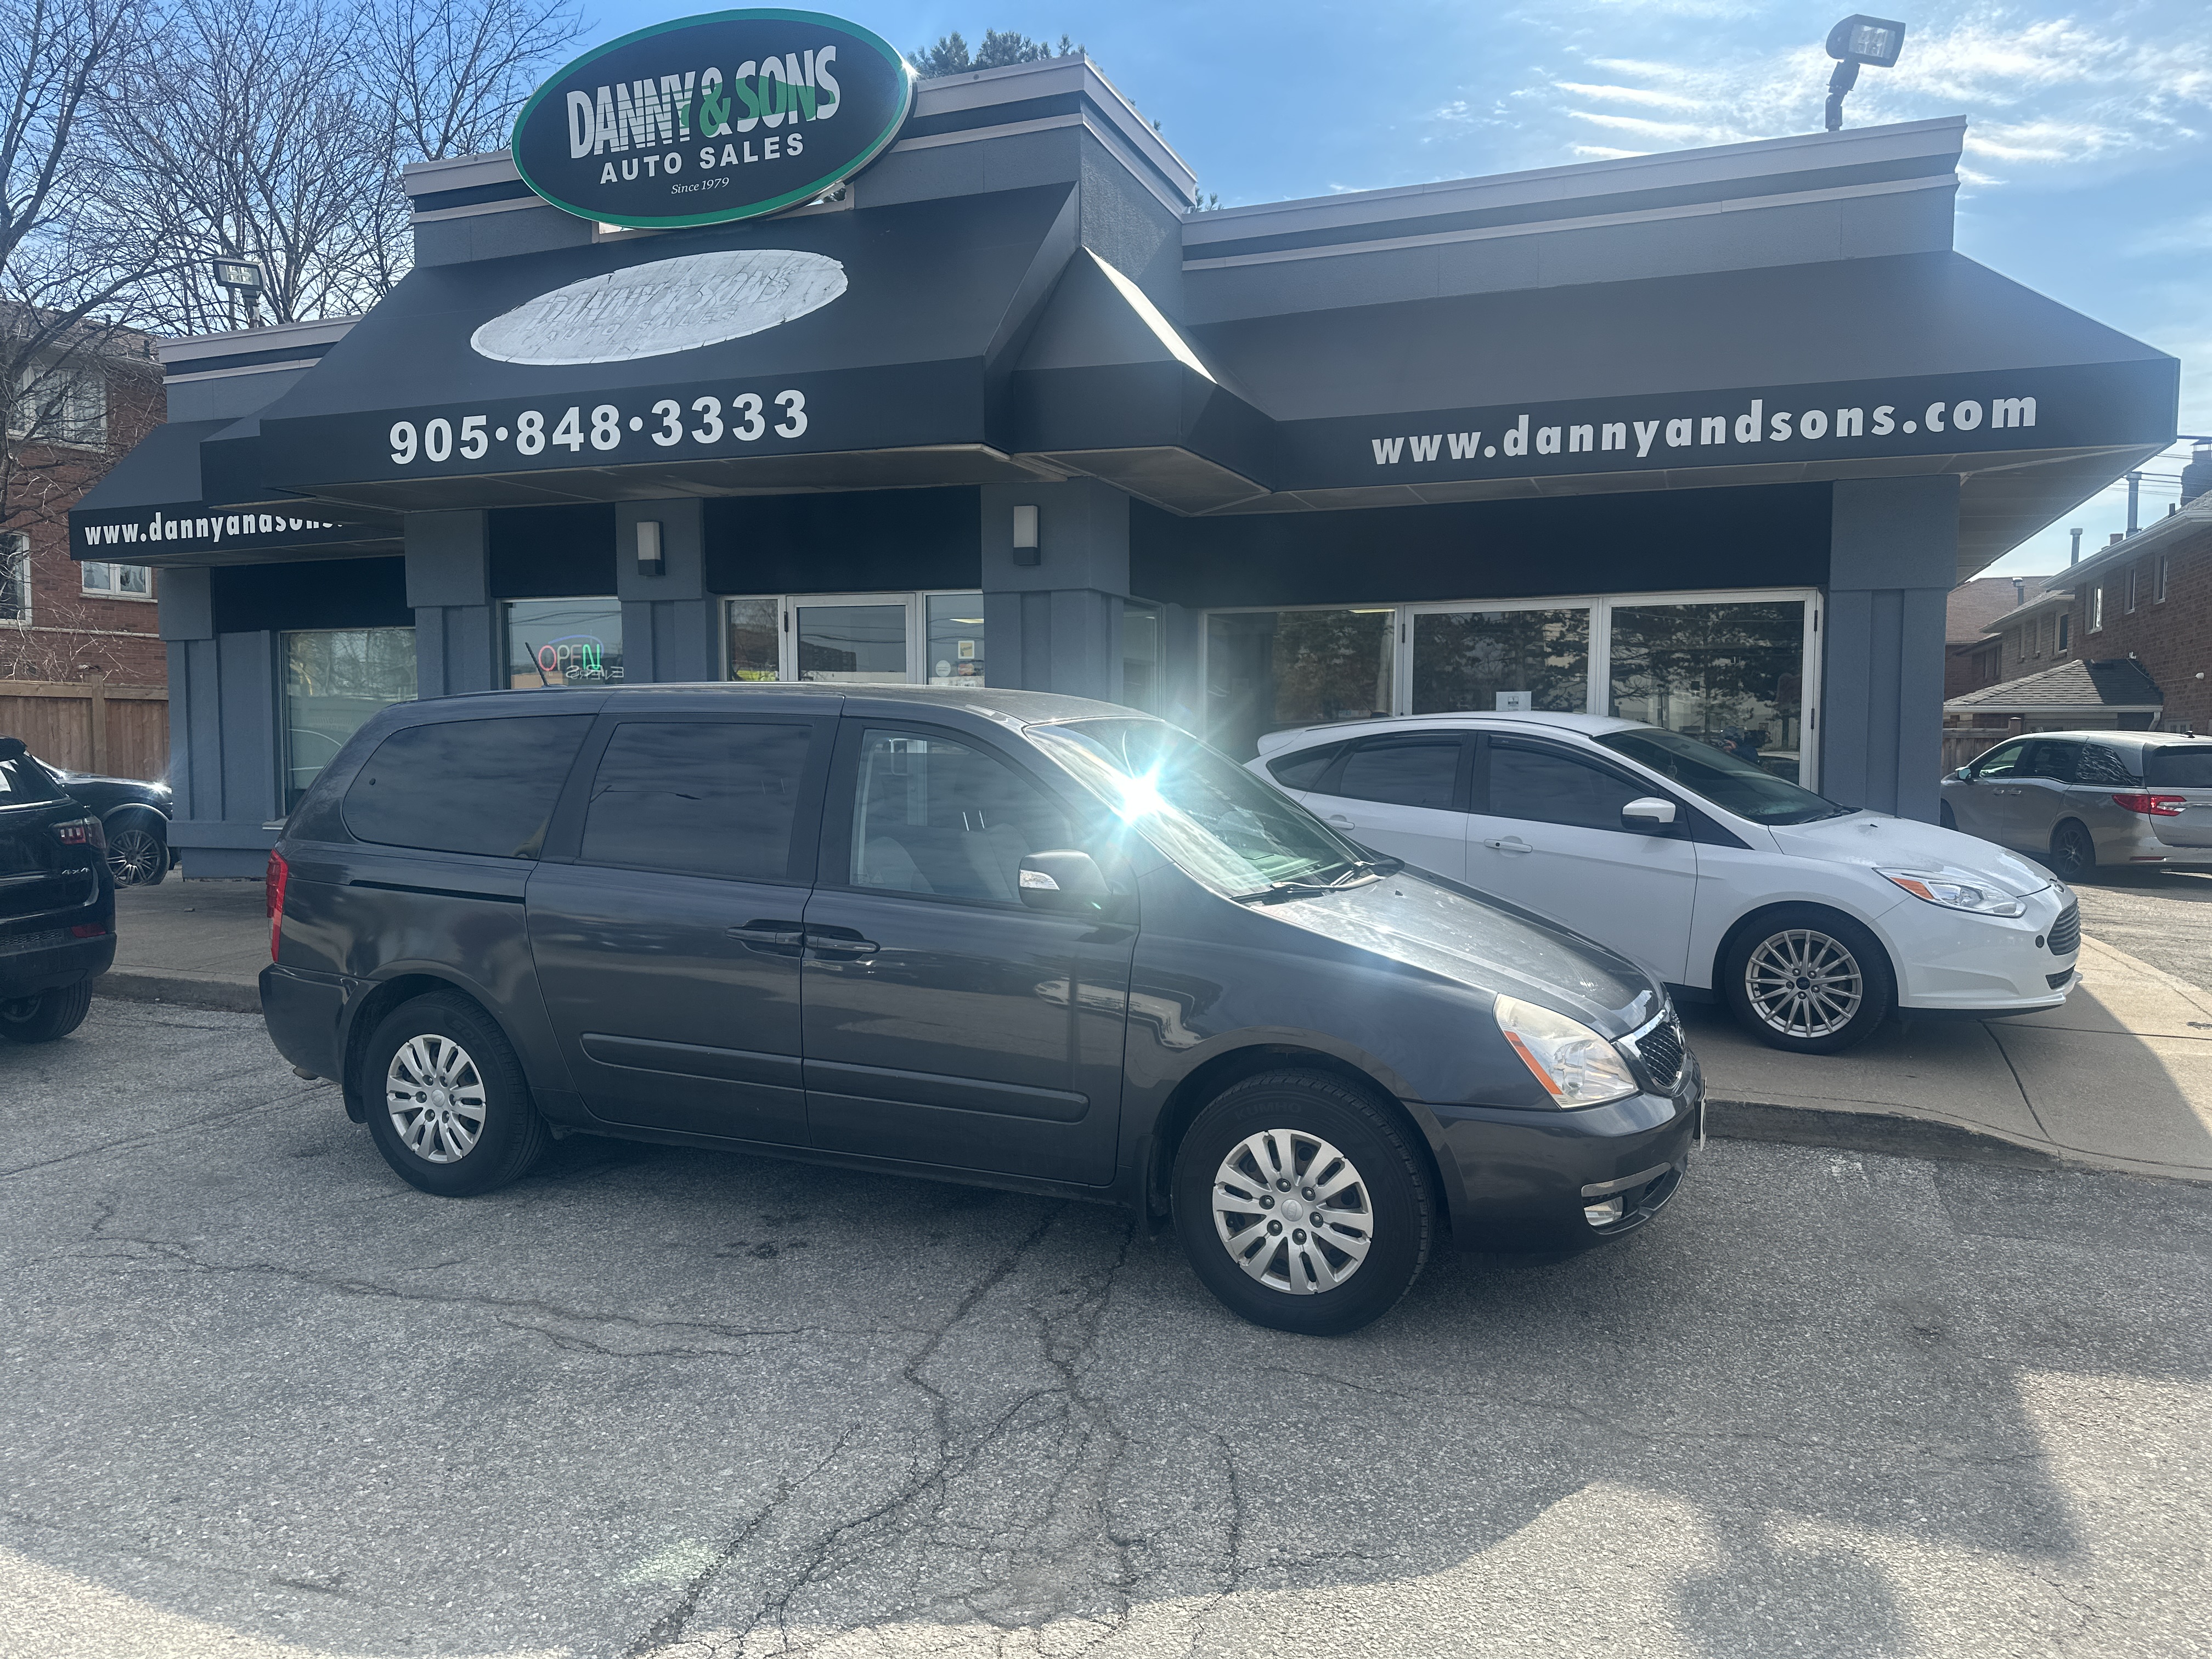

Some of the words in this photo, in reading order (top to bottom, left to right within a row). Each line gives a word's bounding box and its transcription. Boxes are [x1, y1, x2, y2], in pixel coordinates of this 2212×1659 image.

[566, 71, 696, 159] DANNY
[699, 66, 732, 138] &
[736, 45, 841, 133] SONS
[600, 151, 682, 184] AUTO
[700, 133, 804, 170] SALES
[671, 182, 699, 195] Since
[701, 176, 730, 191] 1979
[1372, 396, 2038, 465] www.dannyandsons.com
[538, 644, 600, 671] OPEN
[1235, 1102, 1301, 1121] KUMHO
